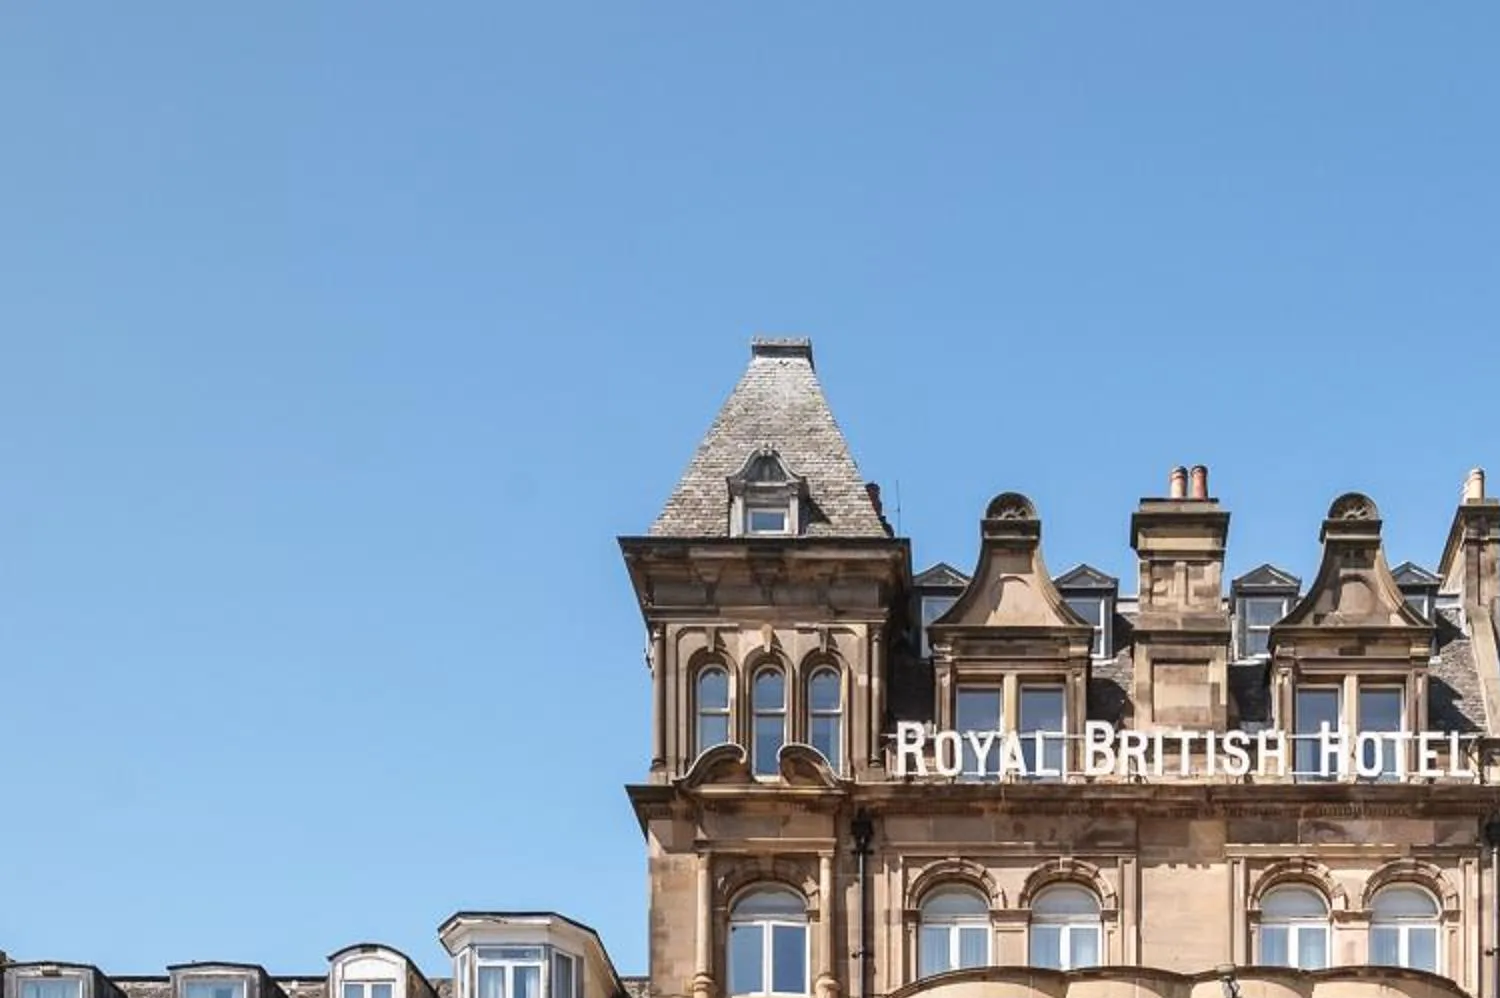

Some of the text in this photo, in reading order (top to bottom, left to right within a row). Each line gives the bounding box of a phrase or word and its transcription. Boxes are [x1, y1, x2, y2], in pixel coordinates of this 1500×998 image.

[896, 720, 1475, 777] ROYAL BRITISH HOTEL
